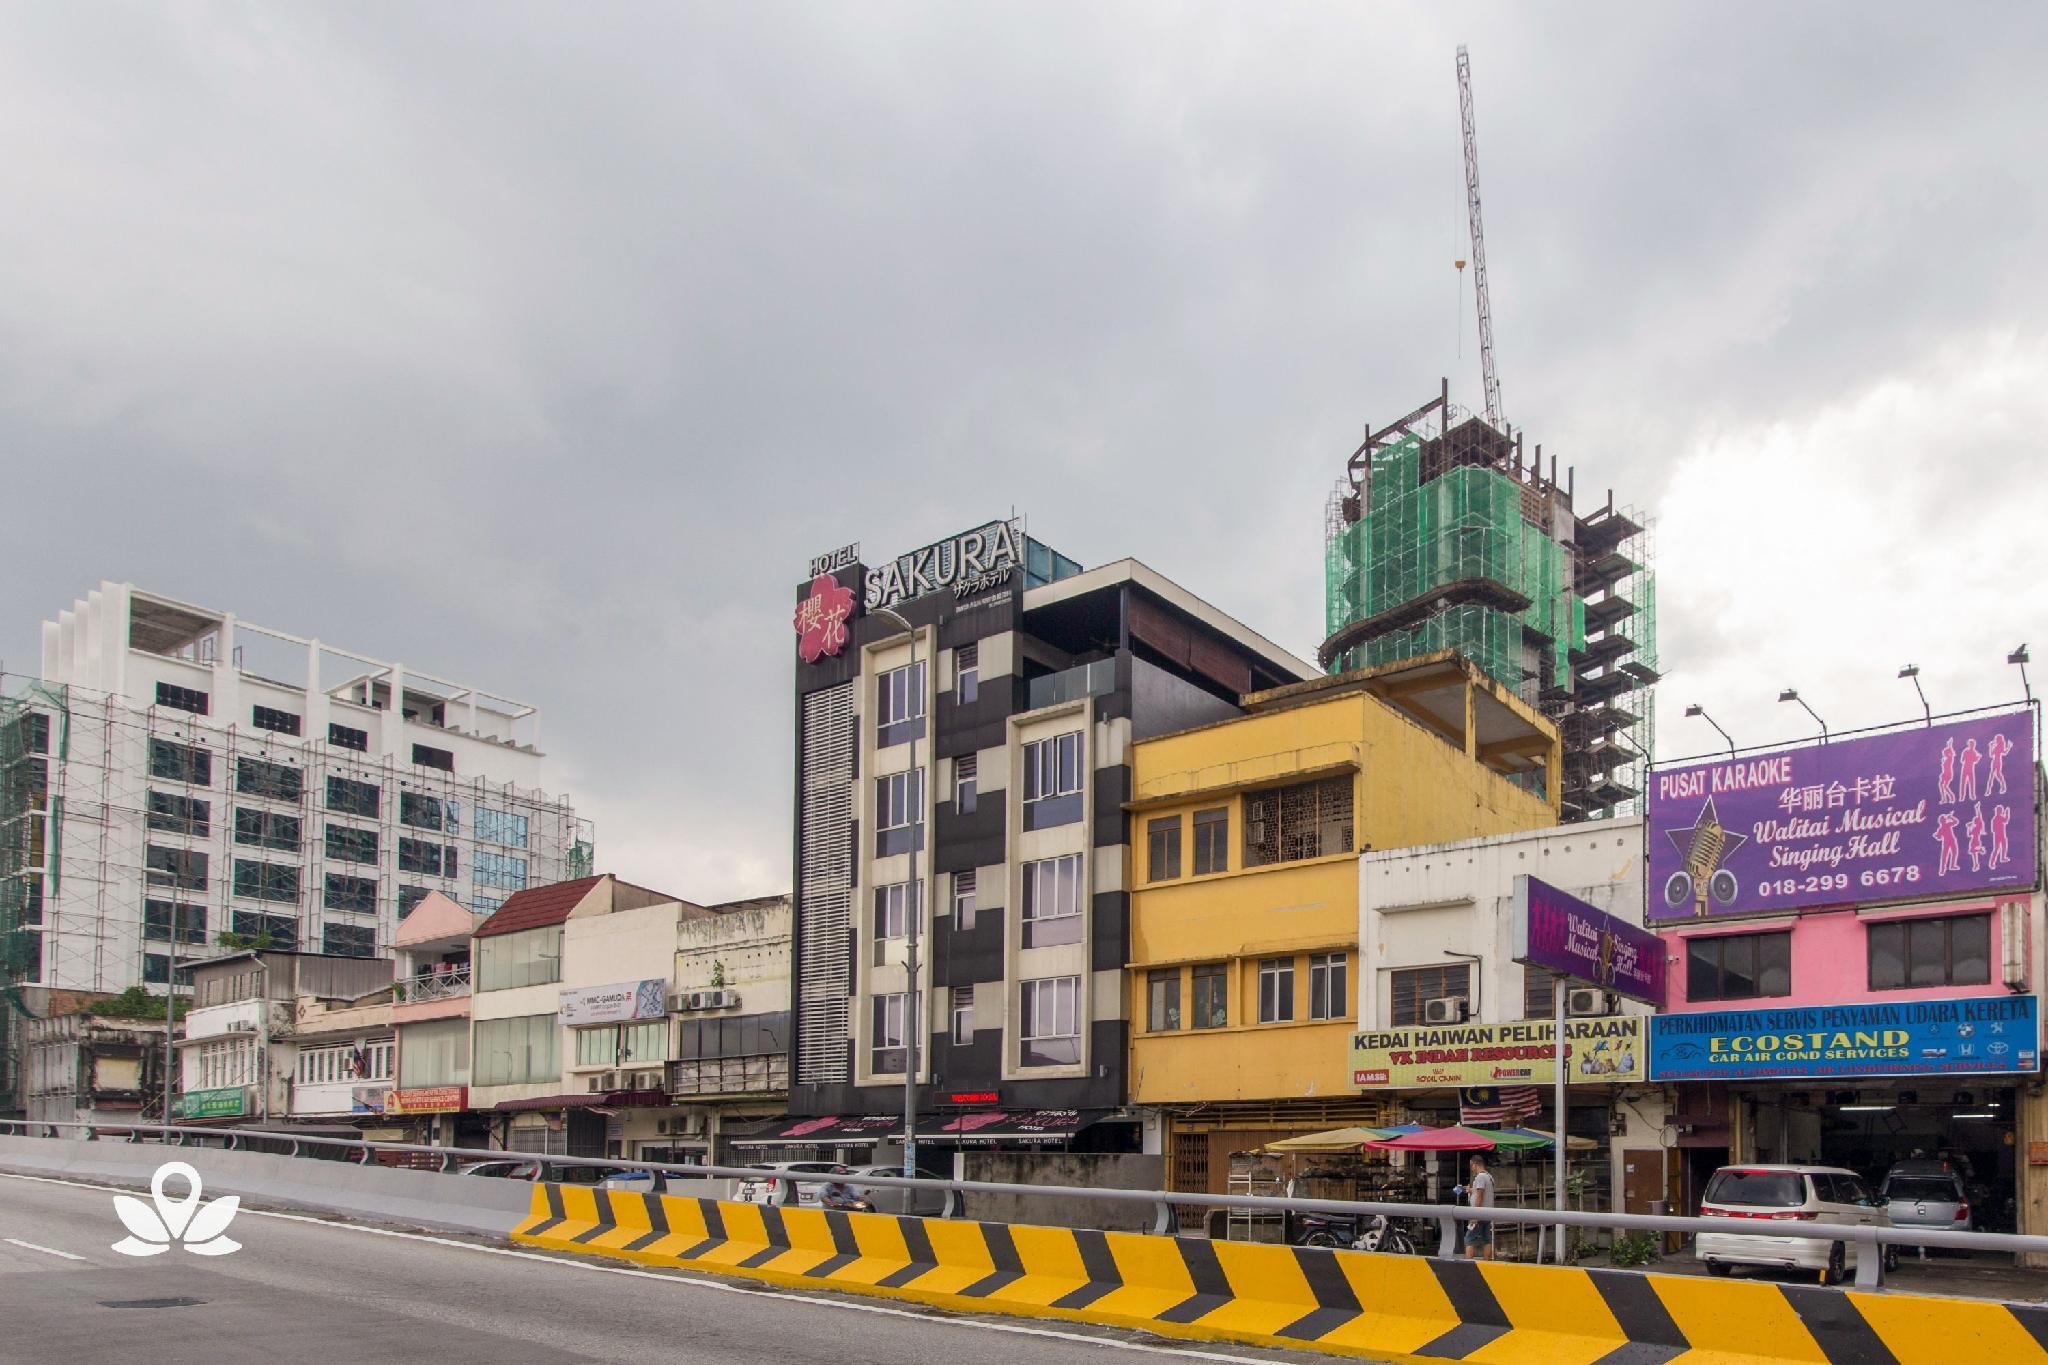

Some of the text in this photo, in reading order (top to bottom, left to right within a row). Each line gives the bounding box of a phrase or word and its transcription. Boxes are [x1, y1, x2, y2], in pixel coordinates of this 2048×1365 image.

[809, 545, 859, 577] HOTEL
[864, 522, 1017, 609] SAKURA
[798, 594, 846, 648] 櫻花
[1660, 756, 1793, 799] PUSAT KARAOKE
[1778, 774, 1897, 813] 华丽台卡拉
[1753, 799, 1926, 844] Walitai Musical
[1768, 831, 1901, 871] Singing Hall
[1758, 865, 1921, 897] 018-299 6678
[1567, 912, 1598, 941] Walitai
[1565, 933, 1601, 960] Musical
[1614, 933, 1638, 964] Singing
[1614, 955, 1633, 976] Hall
[1659, 1000, 2029, 1036] PERKHIDMATAN SERVIS PENYAMAN UDARA KERETA
[1354, 1020, 1637, 1050] KEDAI HAIWAN PELIHARAAN
[1710, 1030, 1910, 1053] ECOSTAND
[1415, 1048, 1469, 1064] INDAH
[1708, 1053, 1740, 1063] CAR
[1744, 1052, 1771, 1062] AIR
[1776, 1050, 1820, 1061] COND
[1824, 1048, 1910, 1059] SERVICES
